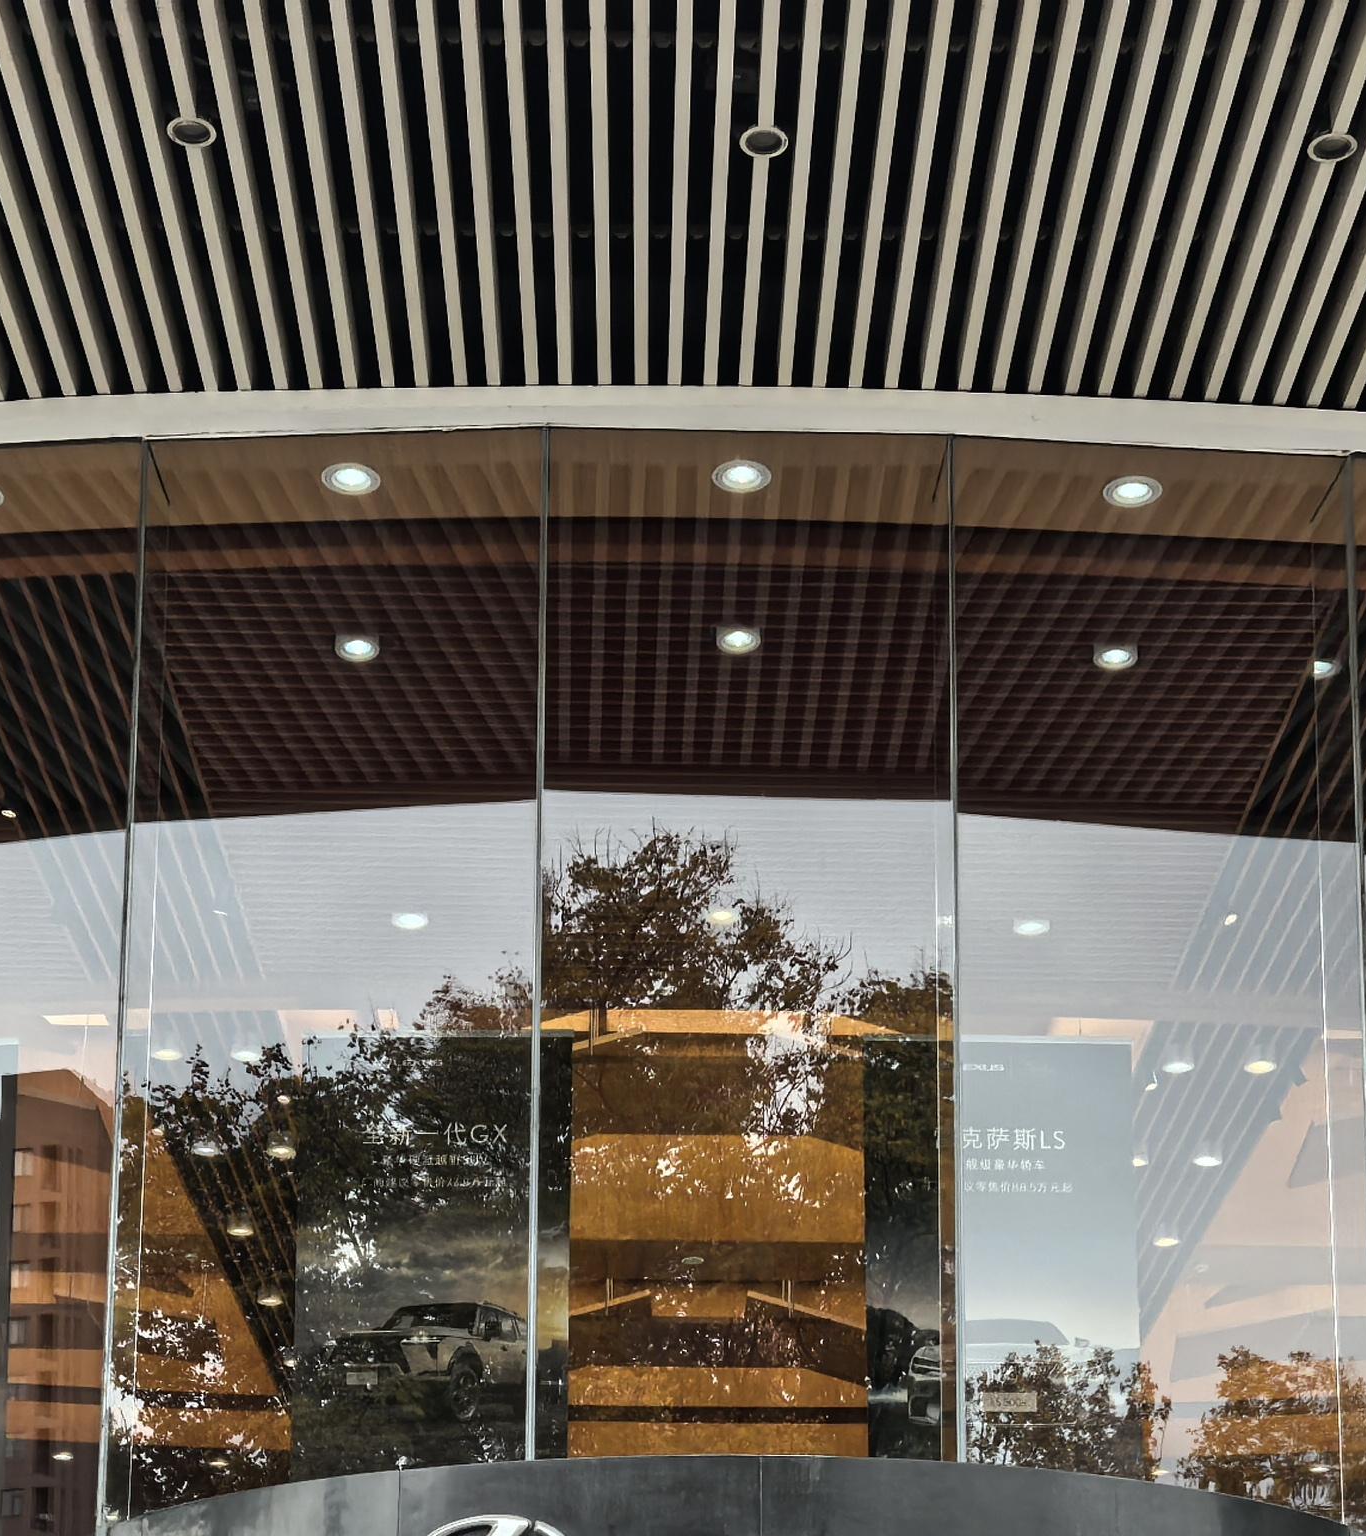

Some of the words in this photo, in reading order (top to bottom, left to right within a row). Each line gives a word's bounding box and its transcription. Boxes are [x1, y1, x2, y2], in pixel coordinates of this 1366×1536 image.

[962, 1063, 1005, 1072] EXUS
[363, 1121, 508, 1147] 全新一代GX
[935, 1126, 1067, 1151] 克萨斯LS
